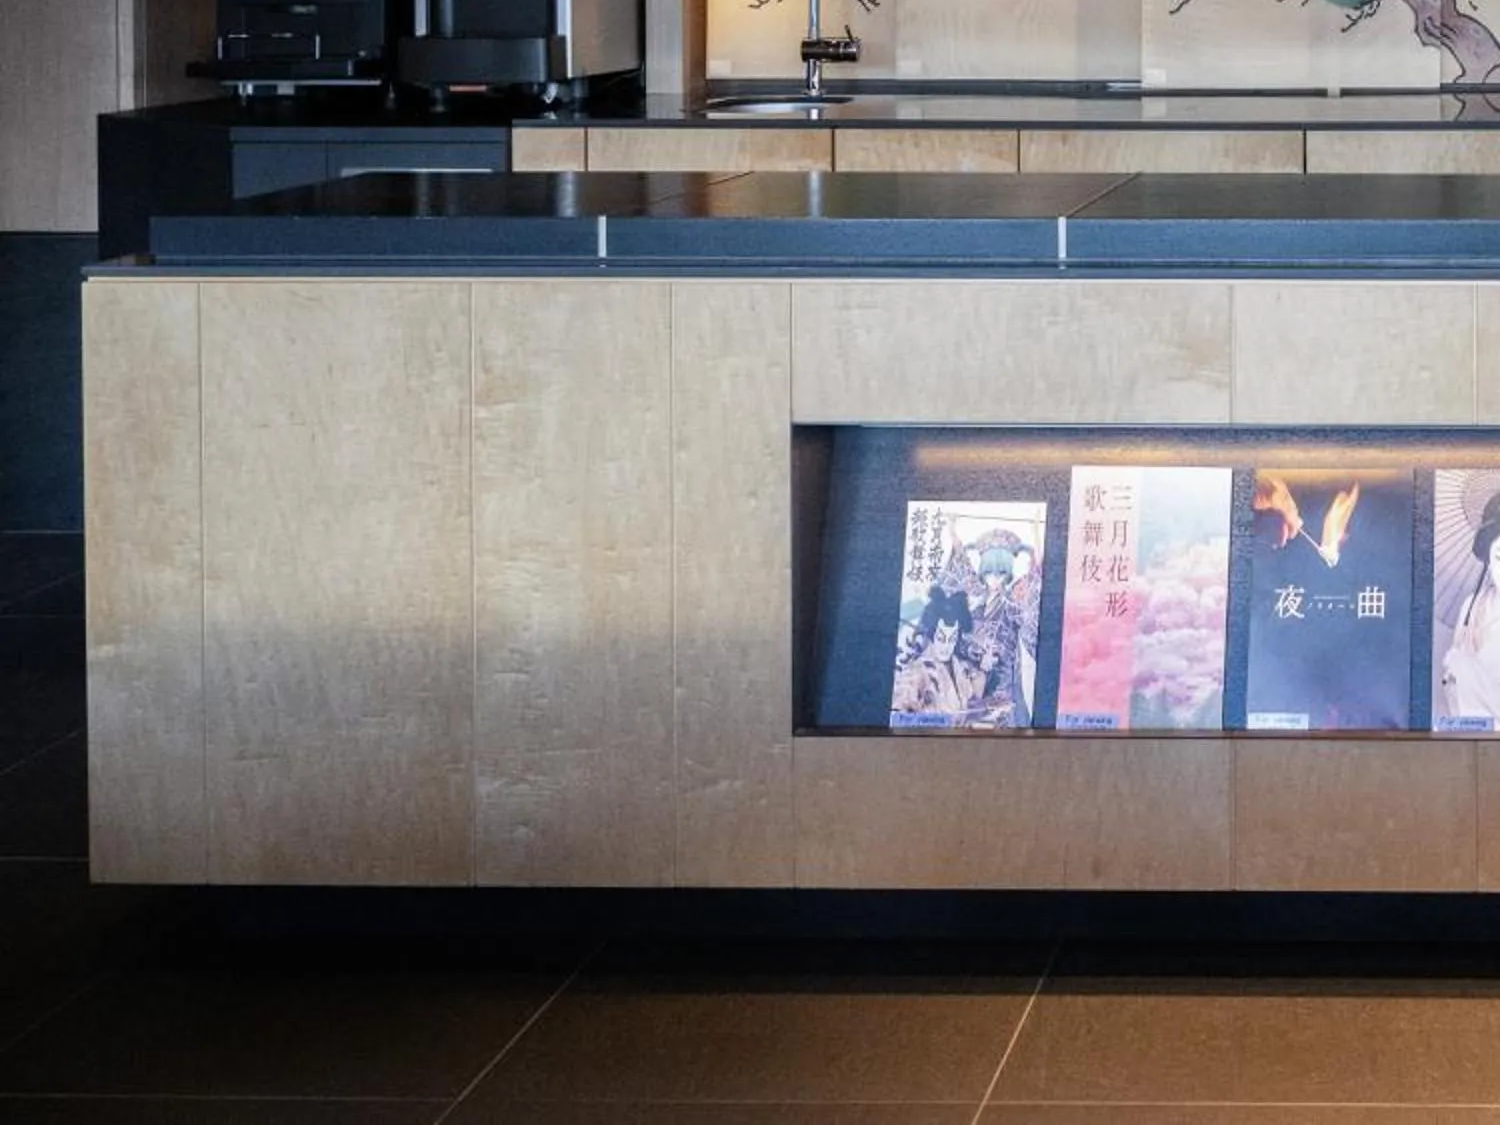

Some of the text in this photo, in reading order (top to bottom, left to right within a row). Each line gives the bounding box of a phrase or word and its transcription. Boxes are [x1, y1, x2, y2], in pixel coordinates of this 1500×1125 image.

[1081, 485, 1107, 582] 歌舞伎
[1106, 485, 1132, 617] 三月花形
[1273, 584, 1305, 619] 夜
[1358, 586, 1385, 619] 曲
